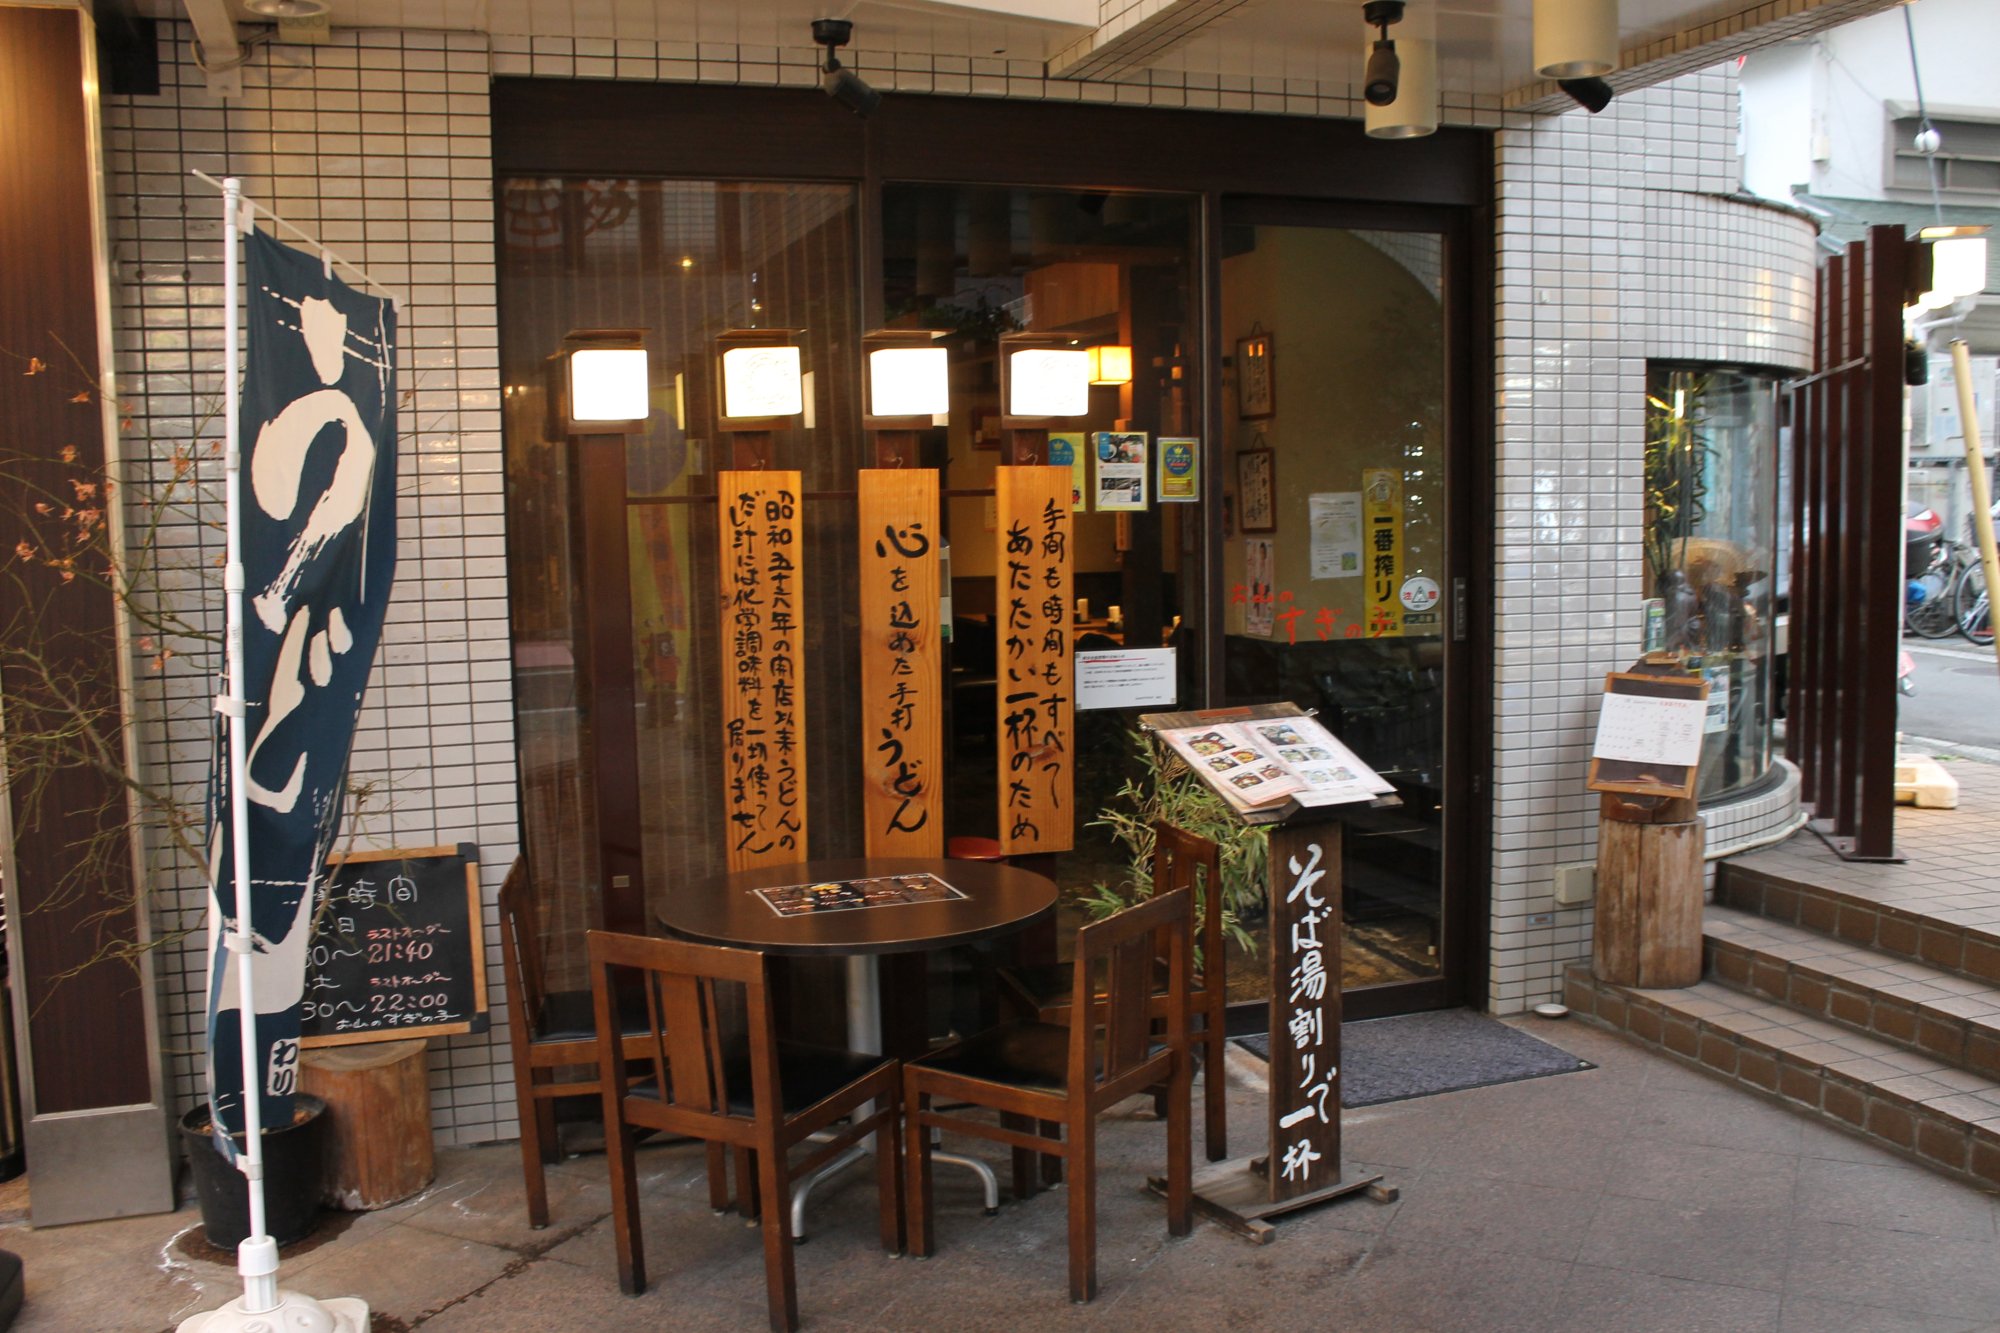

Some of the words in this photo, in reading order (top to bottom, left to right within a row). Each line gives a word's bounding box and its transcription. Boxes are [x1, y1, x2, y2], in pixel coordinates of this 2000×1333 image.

[1040, 497, 1067, 809] 手間も時間もすべて
[1374, 516, 1394, 602] 一番搾り
[765, 490, 801, 850] 昭和五十六年の開店以来うどんの
[875, 522, 930, 836] 心を込めた手打うどん
[1004, 518, 1039, 842] あたたかい一杯のため
[366, 923, 452, 939] ラストオーダー
[367, 940, 433, 964] 21:40
[369, 971, 452, 988] ラストオーダー
[370, 993, 448, 1014] 22:00
[1279, 842, 1337, 1181] そば湯割りで一杯
